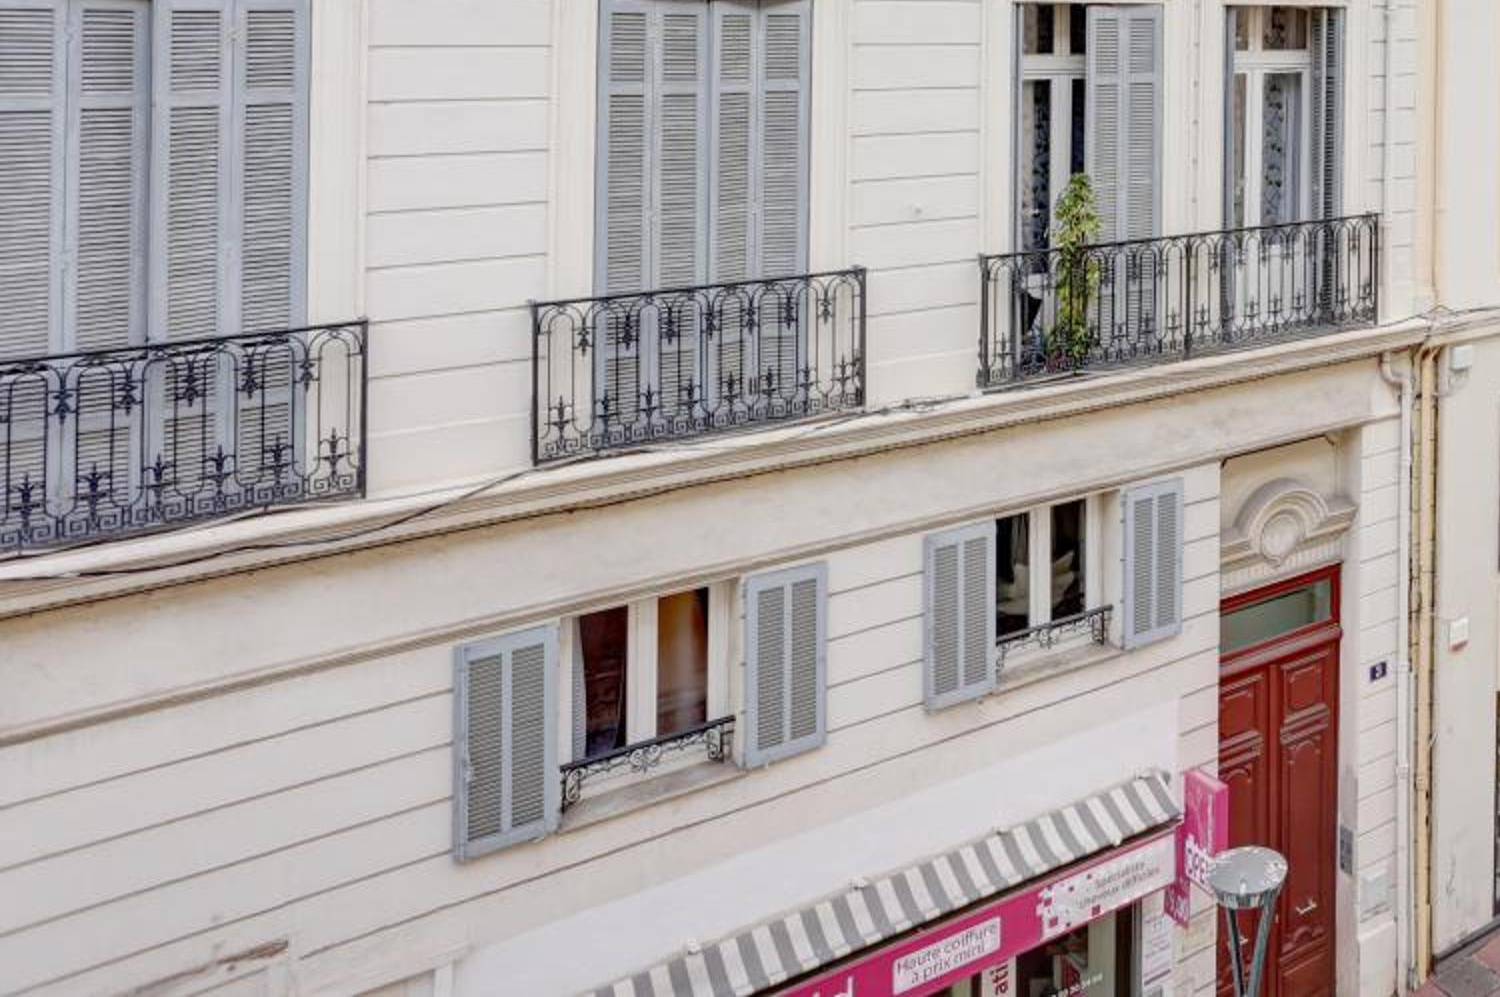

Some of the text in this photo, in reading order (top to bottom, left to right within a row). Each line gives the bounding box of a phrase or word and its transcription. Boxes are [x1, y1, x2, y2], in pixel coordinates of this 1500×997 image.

[897, 924, 997, 974] Haute coiffure
[923, 957, 951, 982] prix
[953, 940, 985, 966] mini
